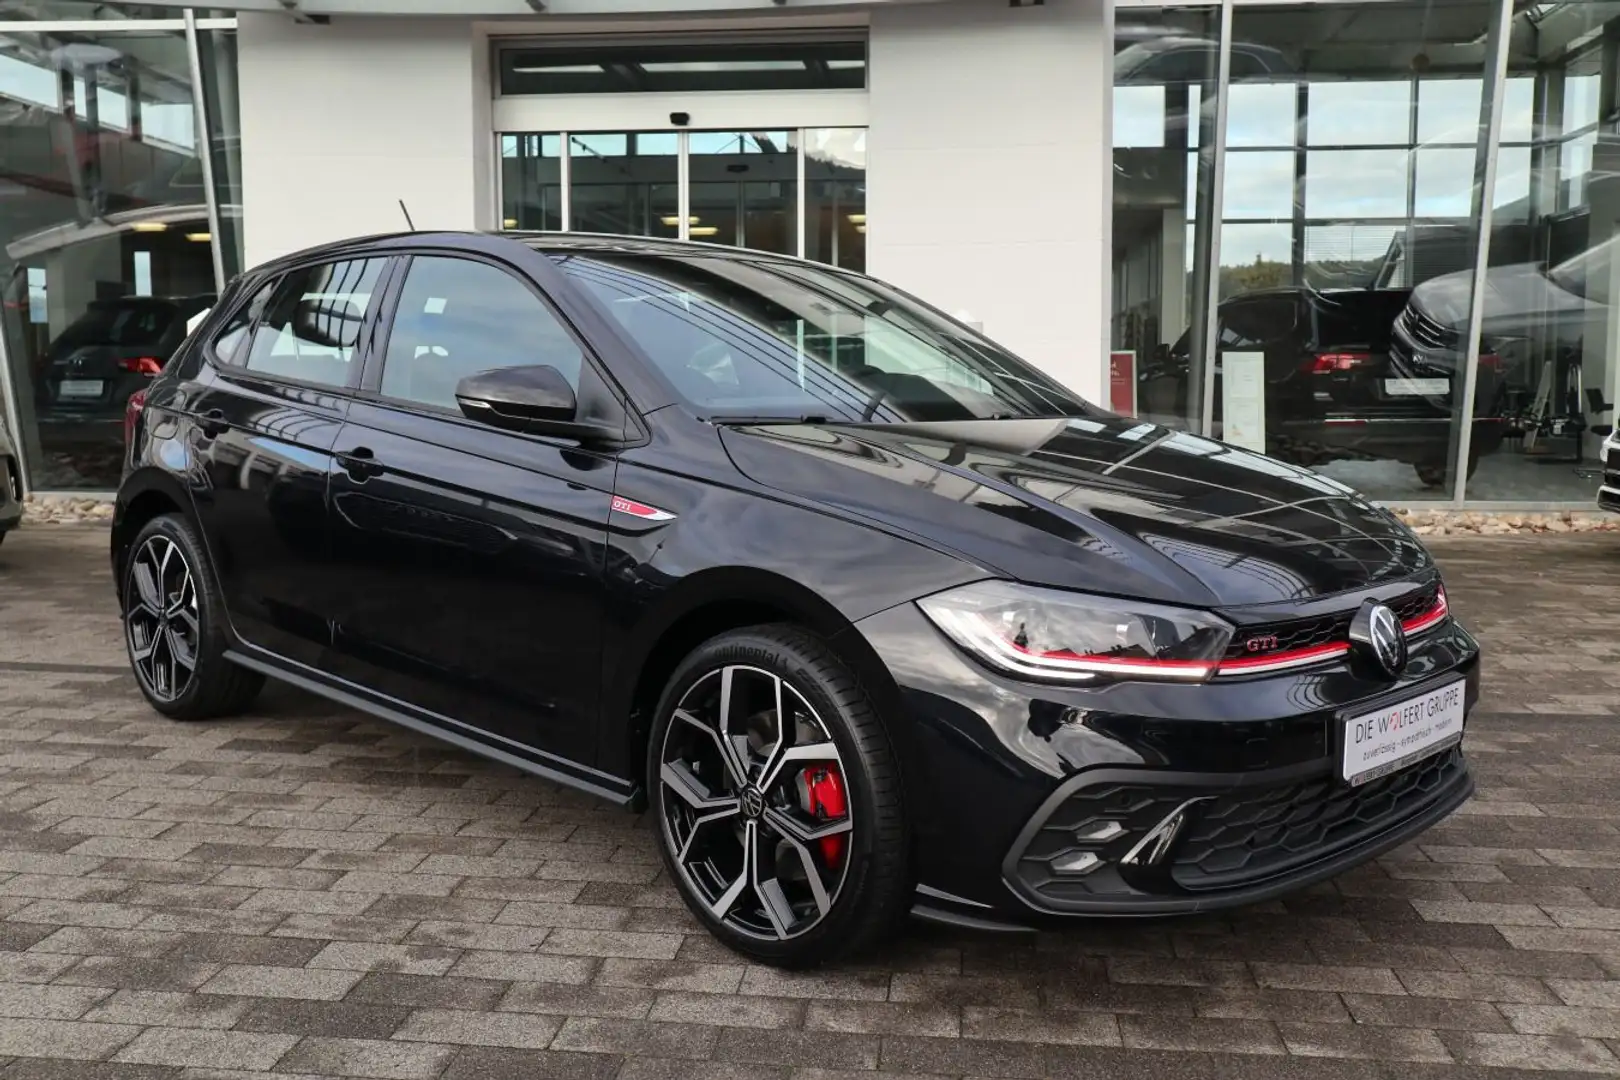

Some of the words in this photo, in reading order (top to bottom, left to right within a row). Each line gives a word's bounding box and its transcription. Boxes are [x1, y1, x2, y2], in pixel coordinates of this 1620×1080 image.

[614, 500, 632, 511] GTI
[1247, 636, 1278, 652] GTI
[1355, 720, 1374, 744] DIE
[1378, 702, 1424, 734] WOLFERT
[1426, 687, 1459, 717] GRUPPE
